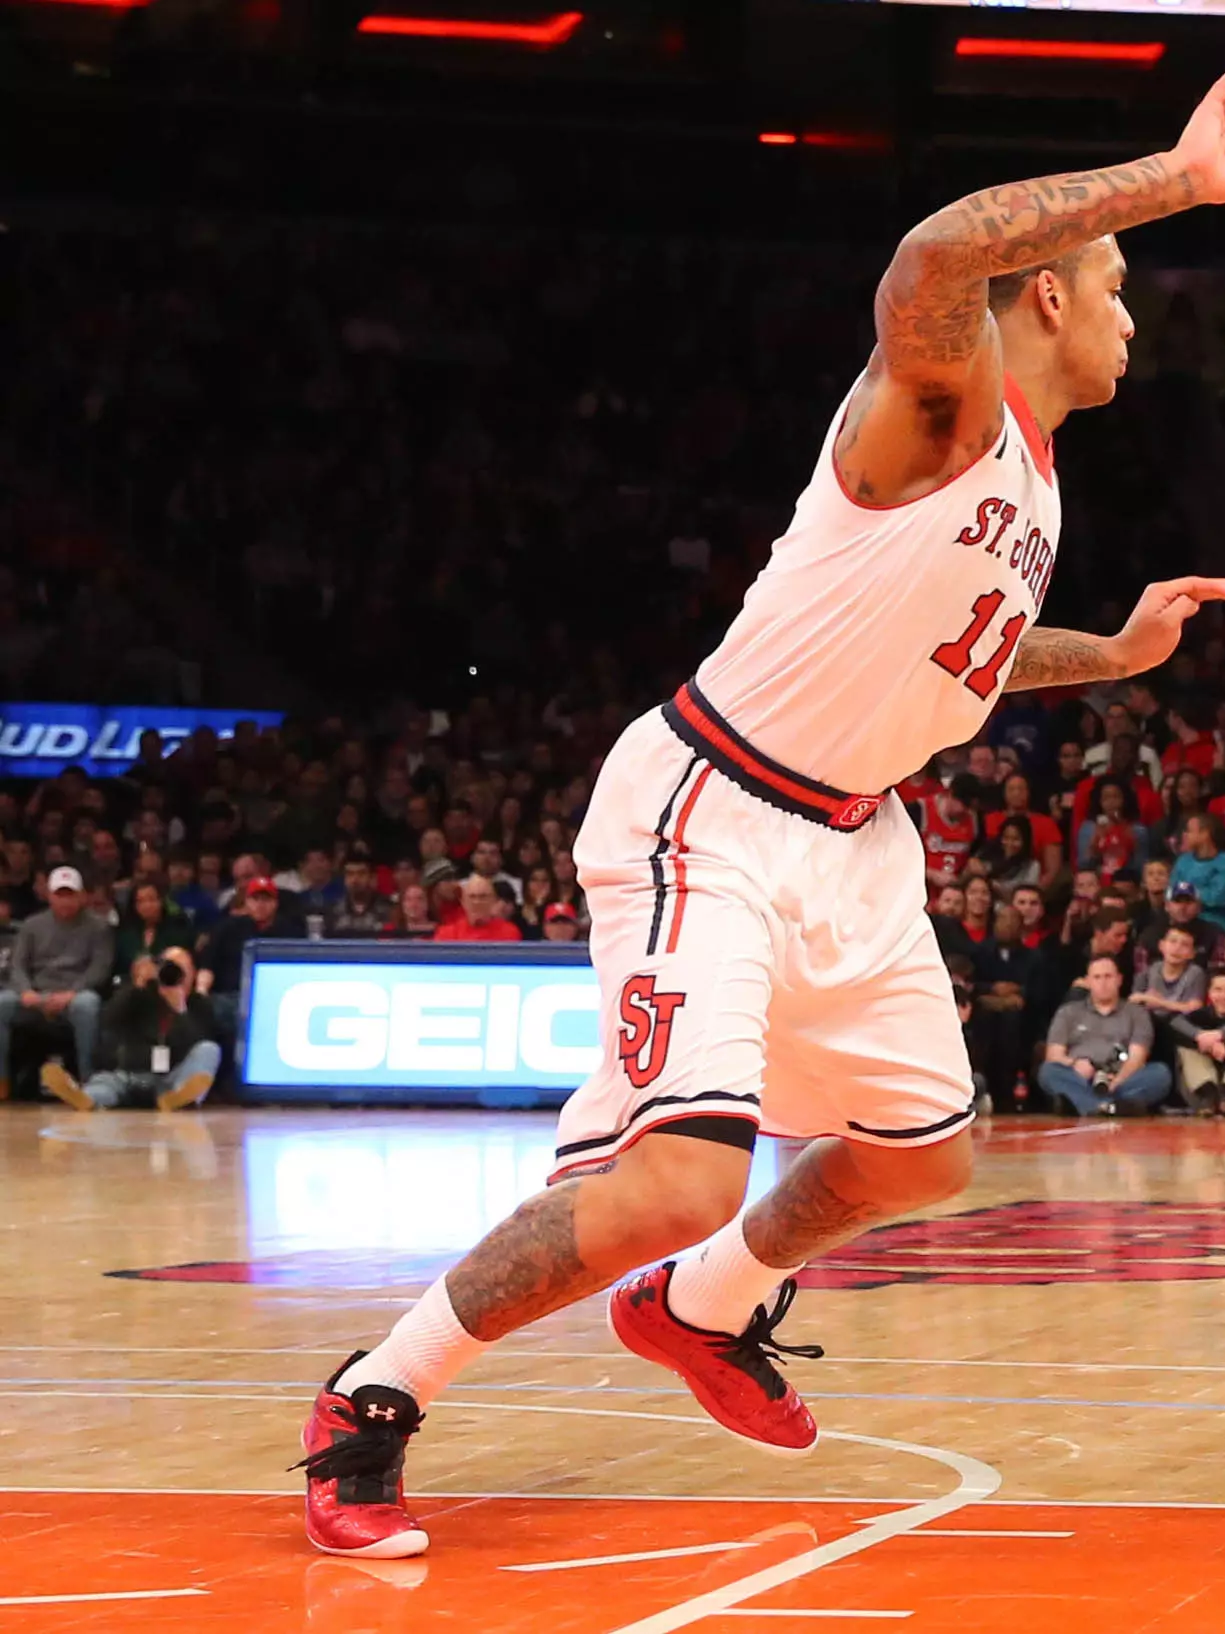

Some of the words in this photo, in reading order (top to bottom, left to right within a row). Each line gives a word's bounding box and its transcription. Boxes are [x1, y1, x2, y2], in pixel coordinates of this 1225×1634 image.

[953, 497, 1018, 559] ST.
[1009, 518, 1056, 614] JOH
[929, 588, 1027, 701] 11
[0, 722, 89, 757] UD
